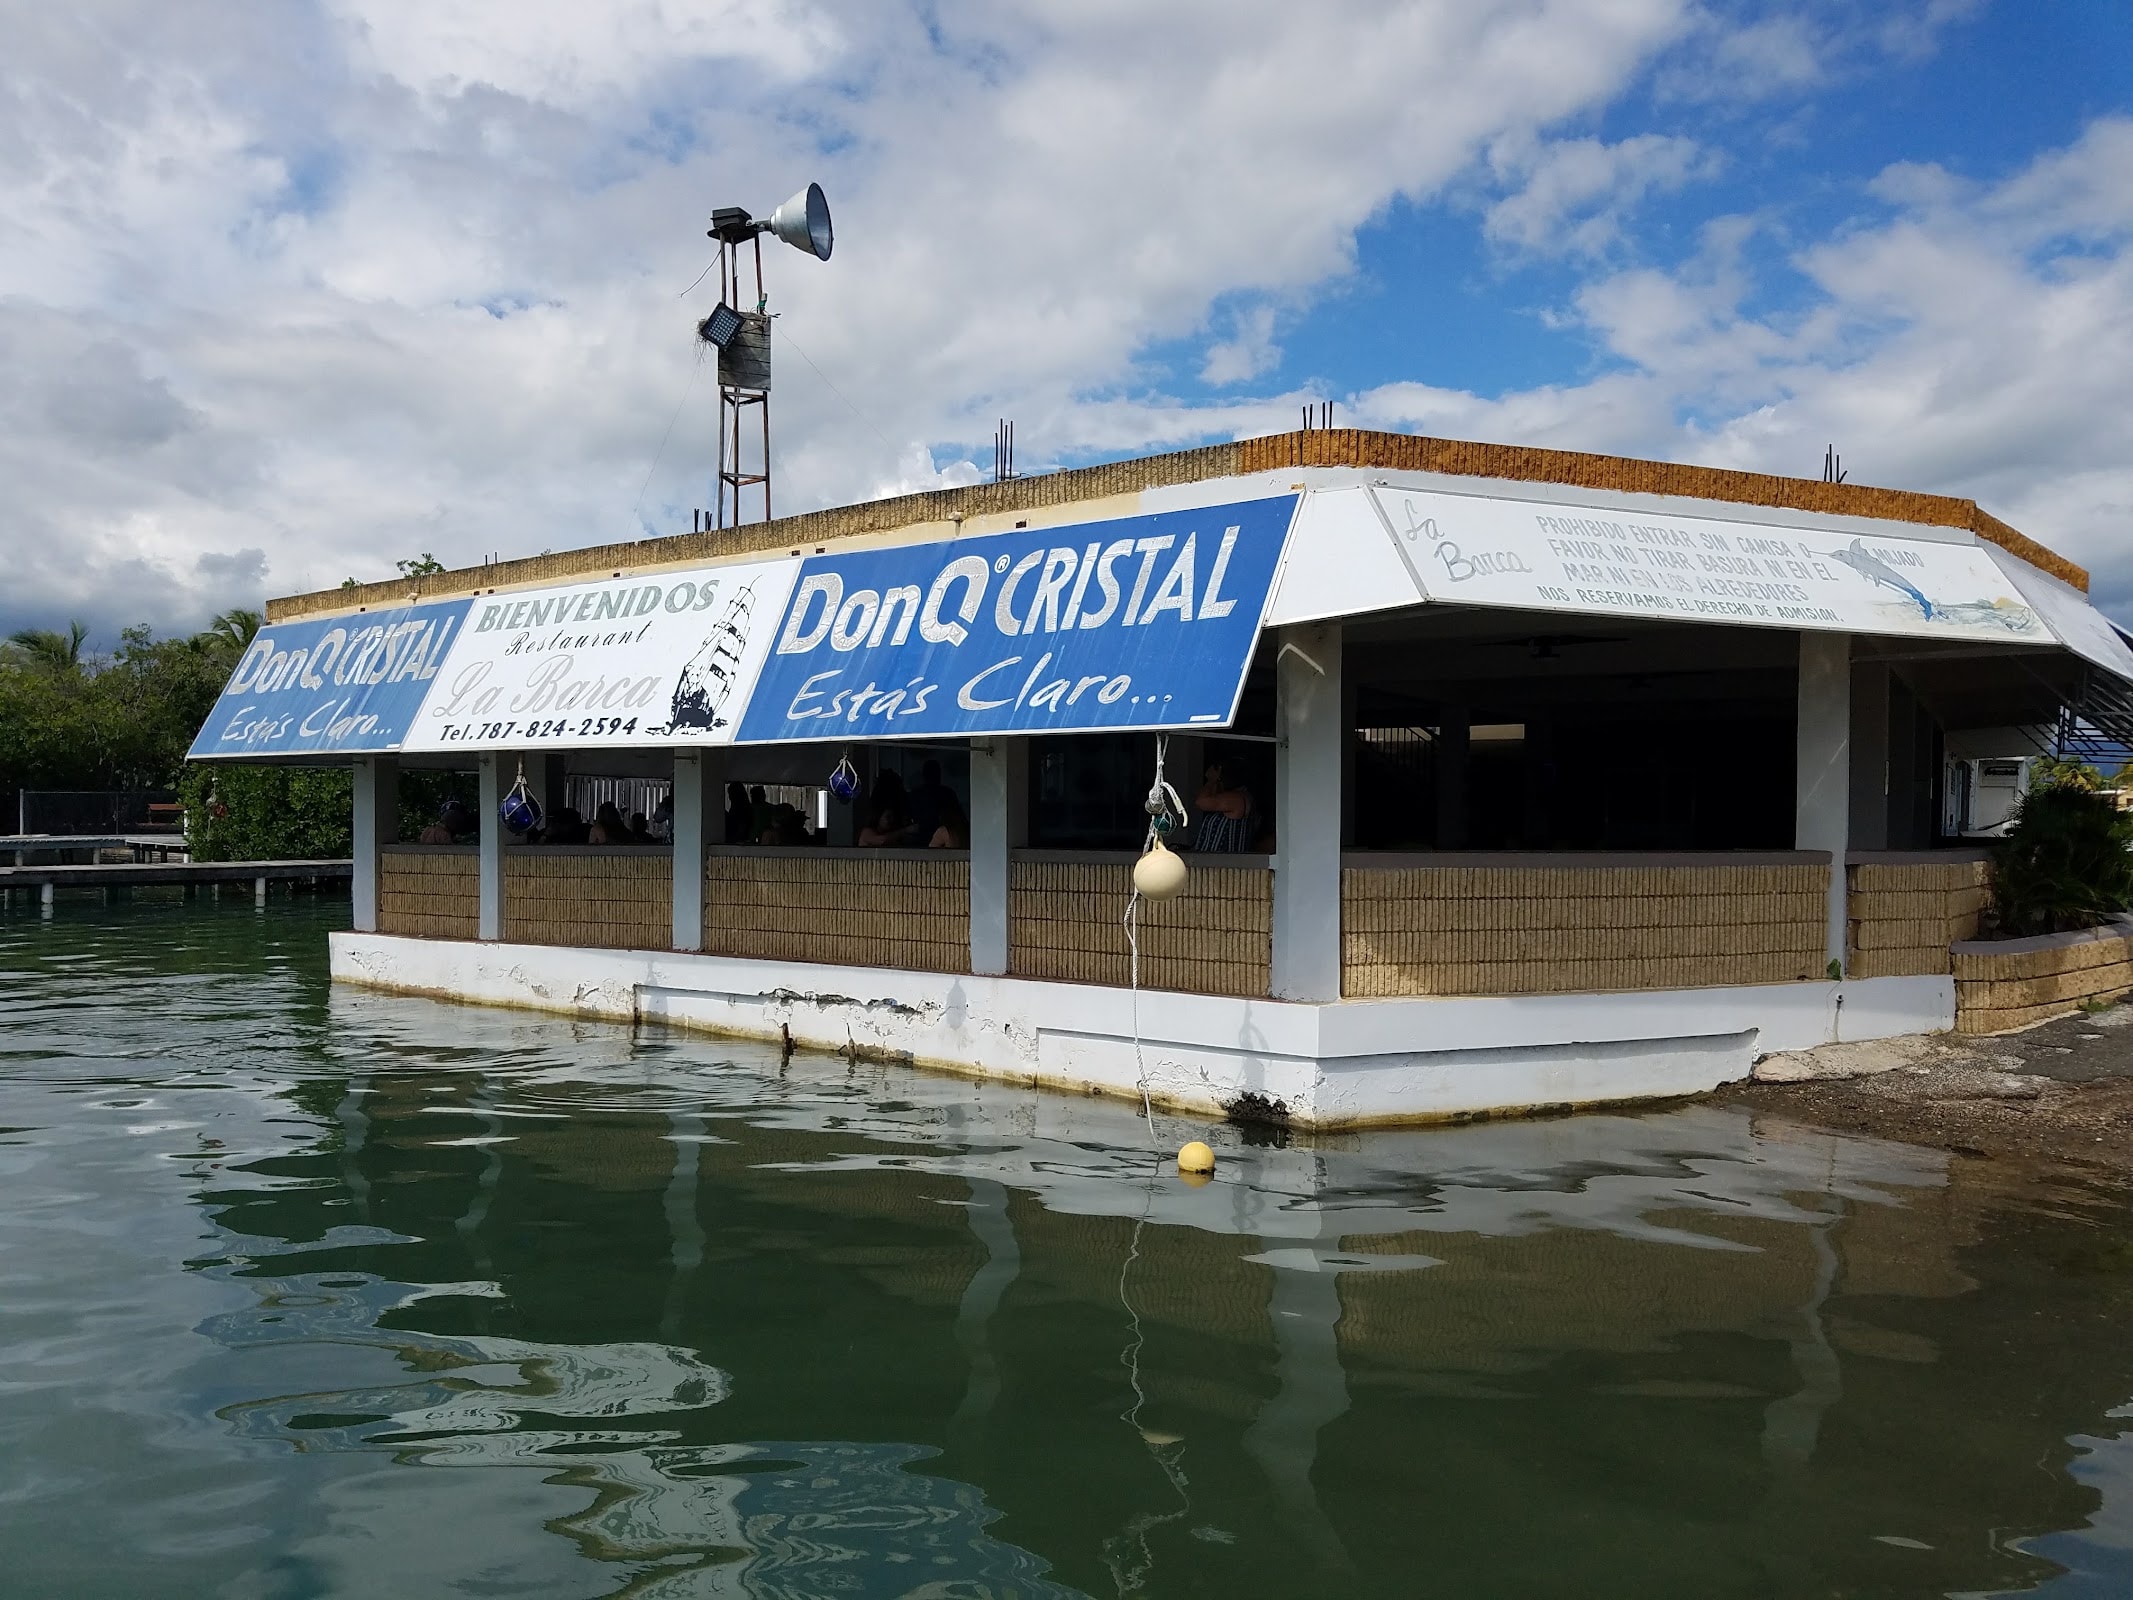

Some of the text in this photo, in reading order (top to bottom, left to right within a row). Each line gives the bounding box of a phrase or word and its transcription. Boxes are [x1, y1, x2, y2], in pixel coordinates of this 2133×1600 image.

[1535, 515, 1625, 541] PROHIBIDO
[1631, 524, 1697, 549] ENTRAR
[1699, 532, 1731, 552] SIN
[1736, 536, 1790, 559] CAMISA
[994, 525, 1240, 636] CRISTAL
[1547, 538, 1839, 582] FAVOR NO TIRAR BASURA NI EN EL
[474, 580, 720, 633] BIENVENIDOS
[1537, 585, 1571, 602] NOS
[1576, 588, 1674, 610] RESERVAMOS
[1675, 597, 1695, 611] EL
[1693, 599, 1754, 617] DERECHO
[1753, 604, 1773, 617] DE
[1611, 567, 1632, 586] NI
[1695, 576, 1810, 602] ALREDEDORES
[334, 616, 455, 686] CRISTAL
[504, 621, 653, 656] Restaurant
[432, 654, 662, 718] La Barca
[786, 669, 939, 724] Estás
[221, 706, 294, 743] Estás
